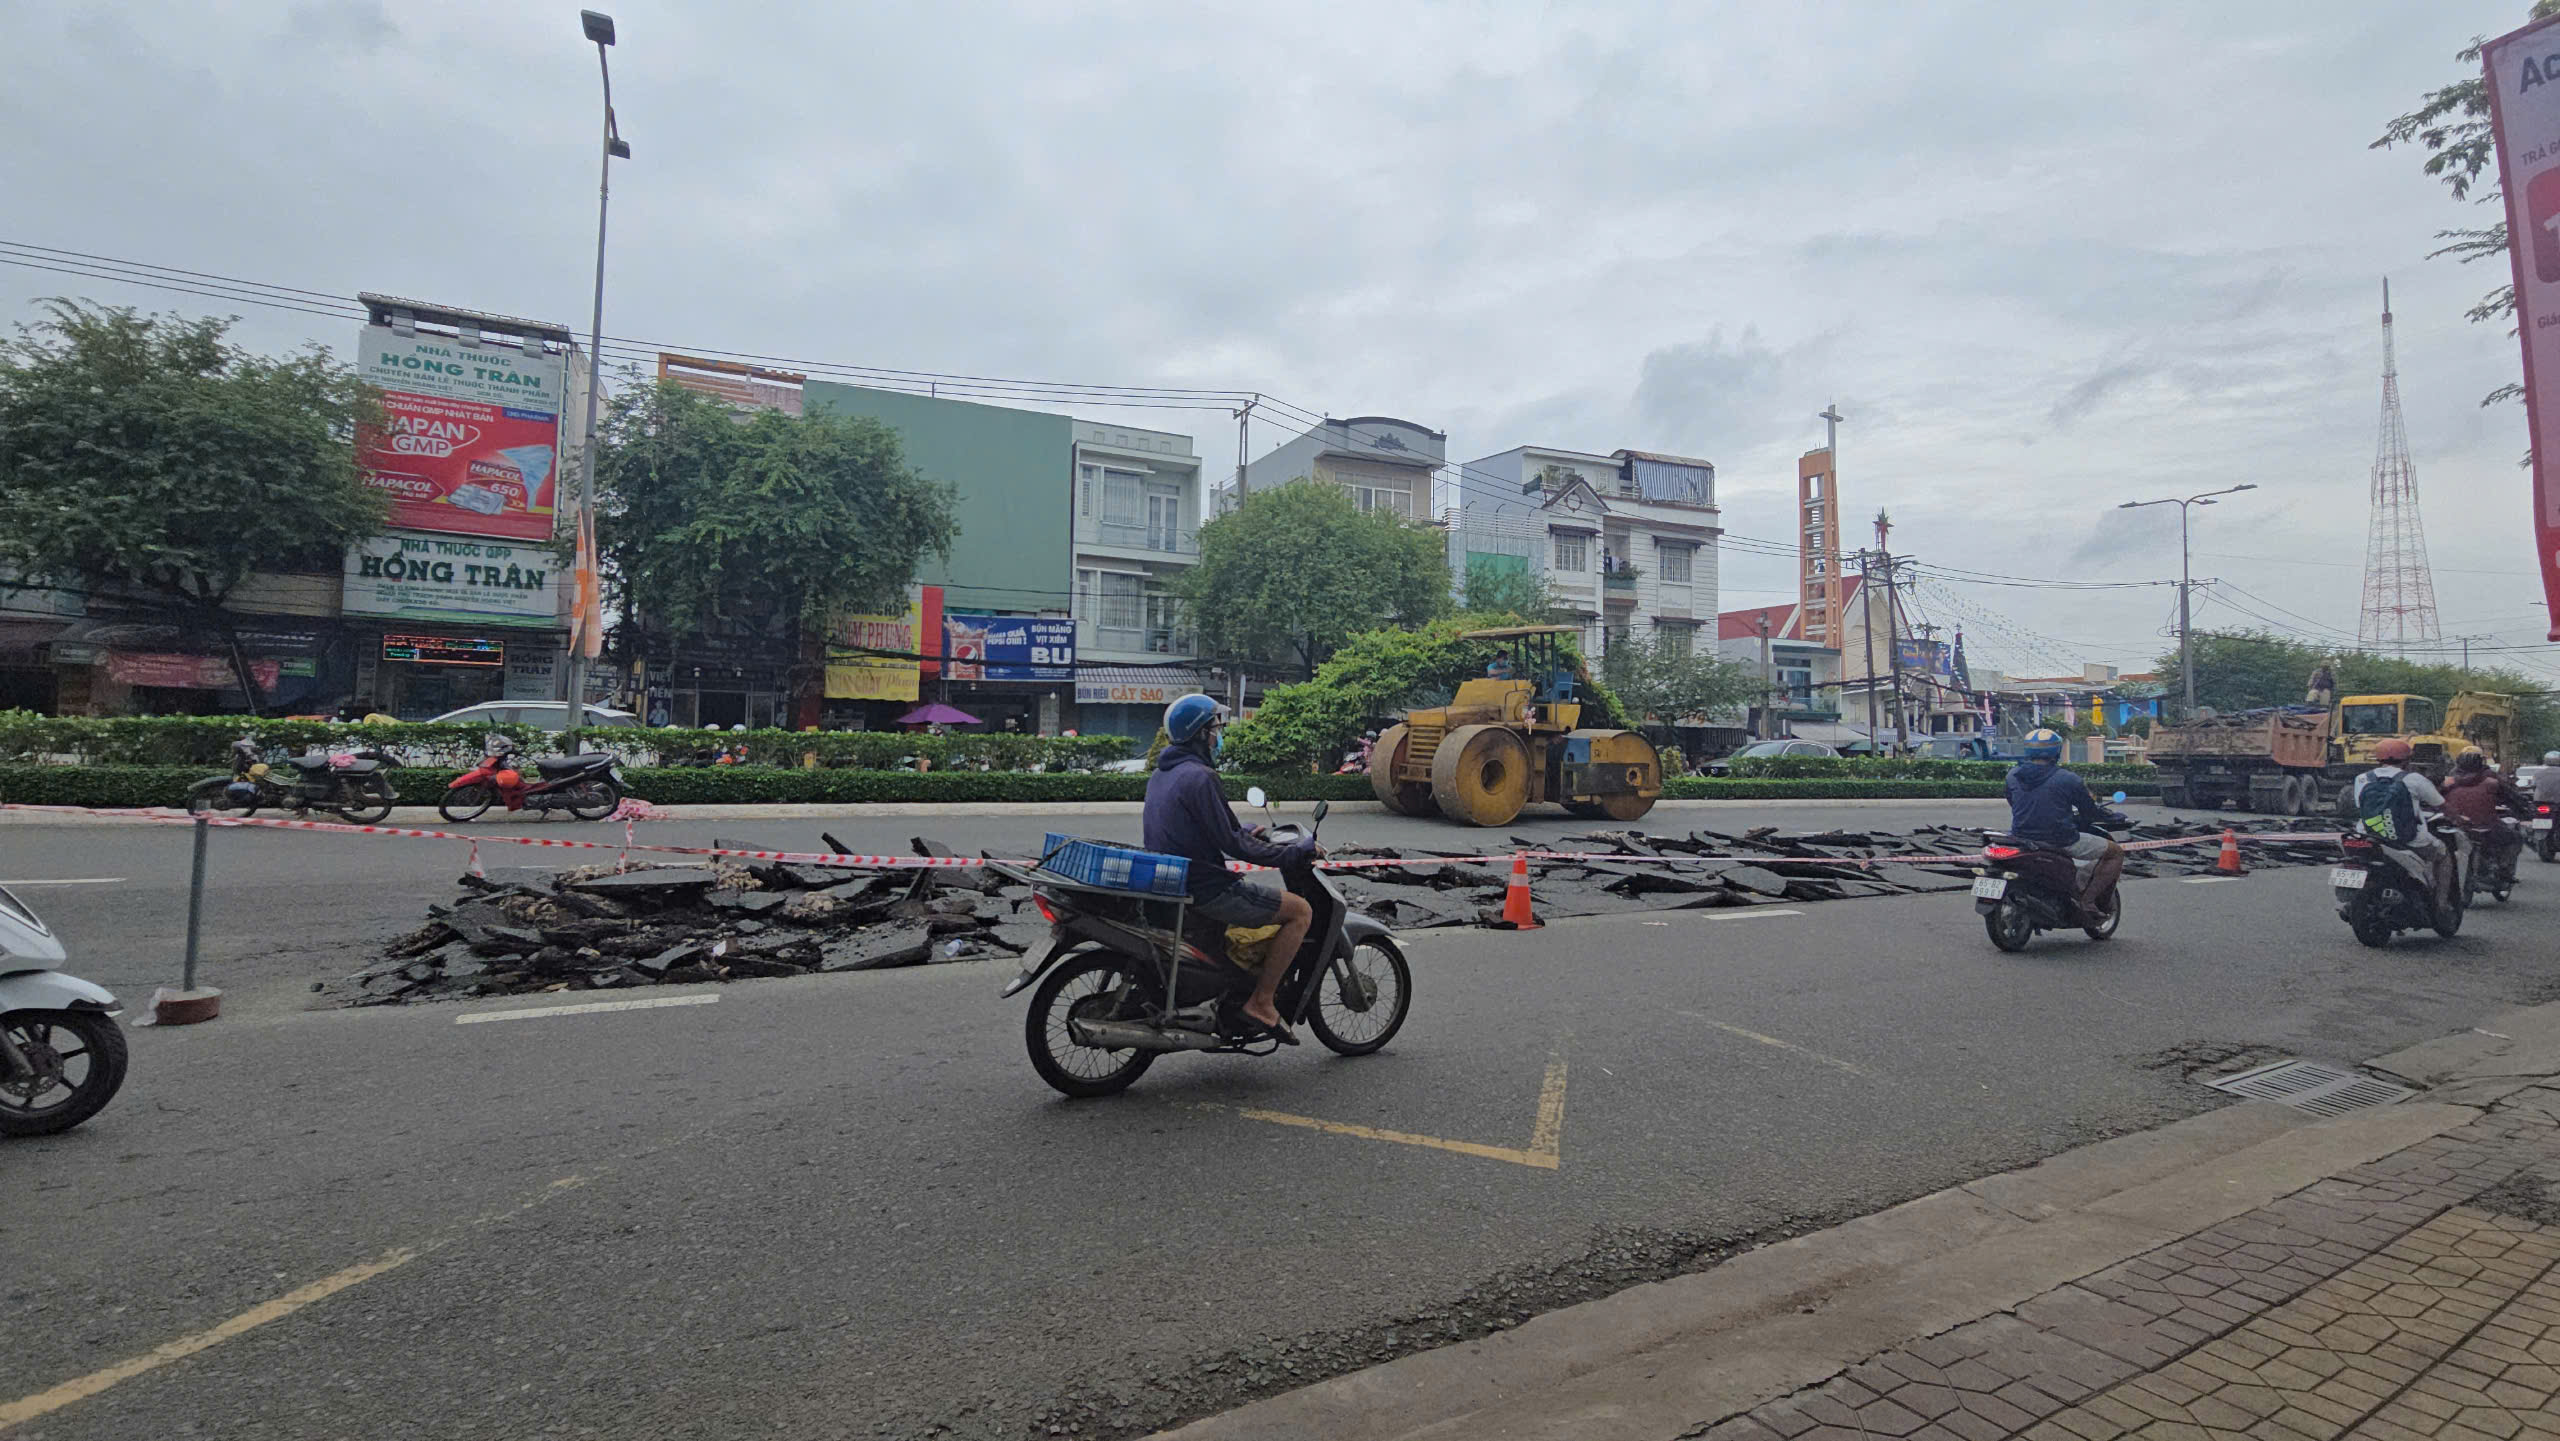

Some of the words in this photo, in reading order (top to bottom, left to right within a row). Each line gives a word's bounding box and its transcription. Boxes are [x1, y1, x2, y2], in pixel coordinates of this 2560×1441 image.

[396, 436, 449, 455] GMP
[470, 463, 520, 481] HAPACOL
[361, 475, 433, 493] HAPACOL
[490, 483, 519, 498] 650
[465, 562, 545, 590] TRÂN
[1031, 647, 1072, 665] BU
[1140, 687, 1164, 701] SAO
